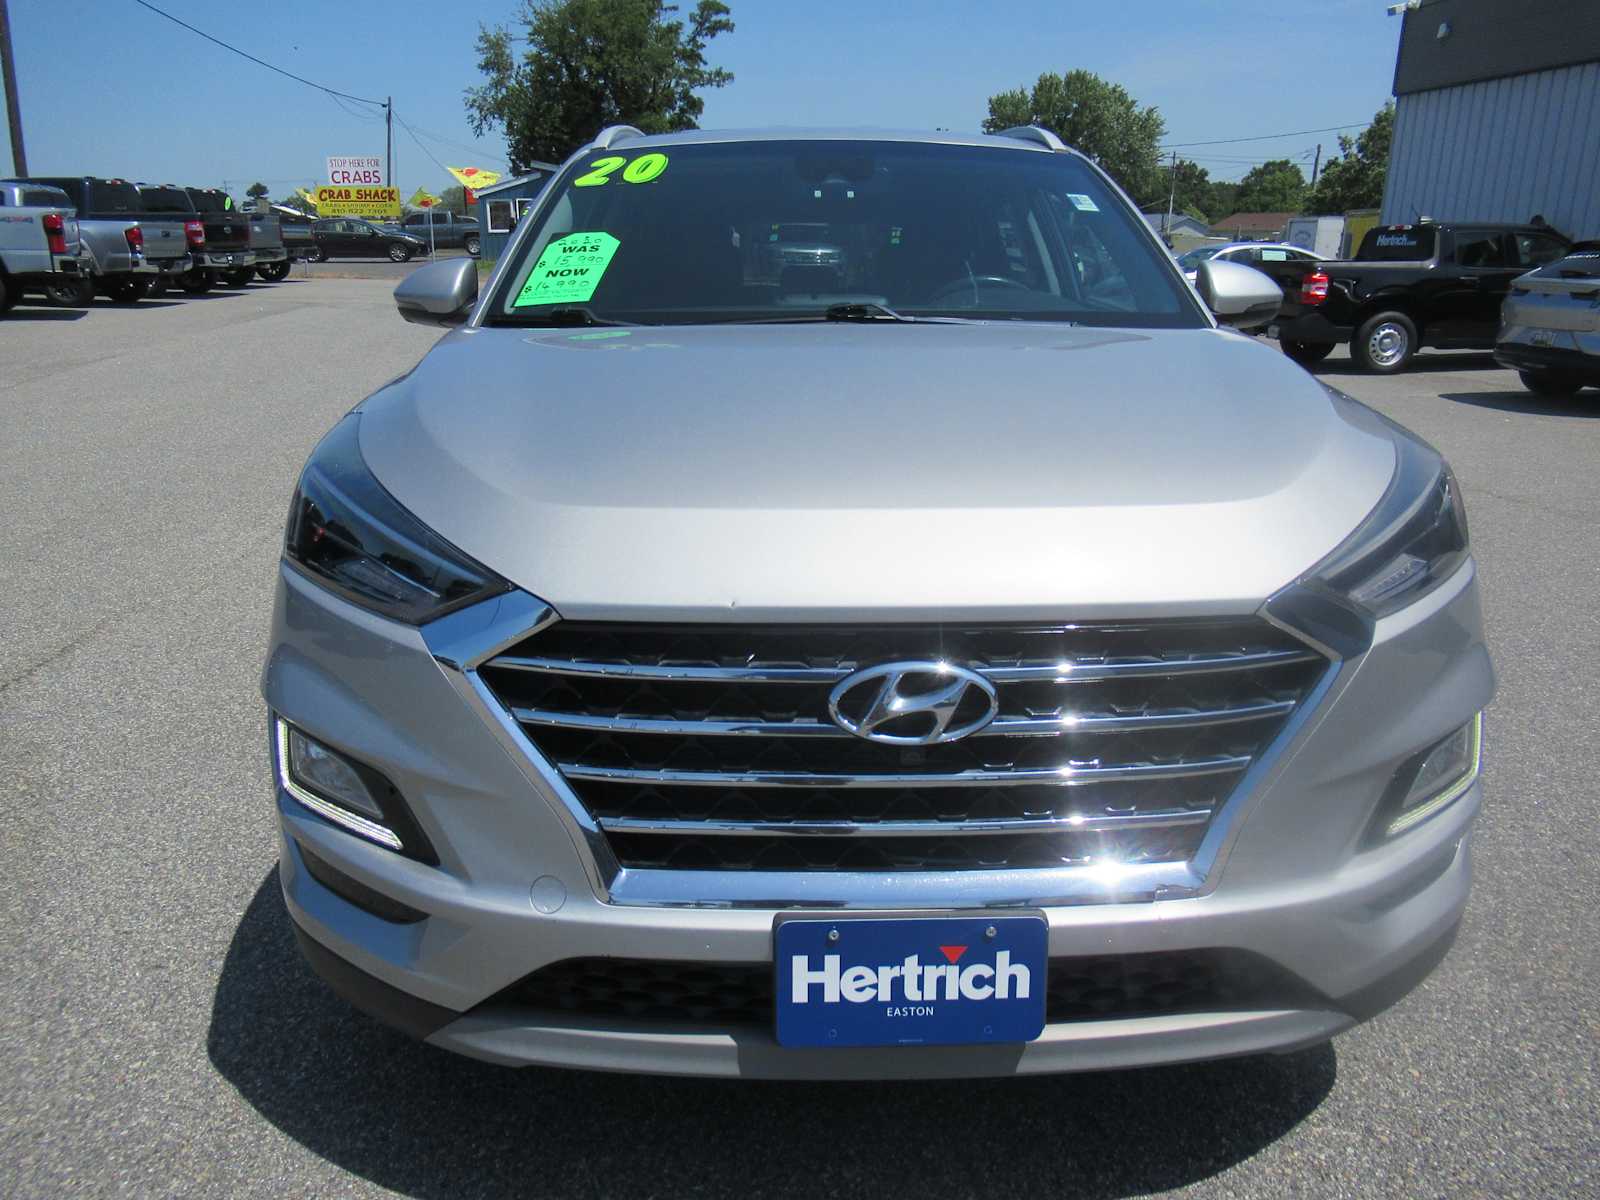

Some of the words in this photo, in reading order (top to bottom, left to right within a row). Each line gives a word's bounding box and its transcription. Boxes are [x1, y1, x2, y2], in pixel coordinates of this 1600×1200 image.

[329, 158, 347, 168] STOP
[349, 158, 365, 168] HERE
[366, 158, 380, 168] FOR
[331, 170, 381, 184] CRABS
[574, 153, 669, 188] 20
[318, 188, 352, 202] CRAB
[356, 188, 397, 202] SHACK
[1376, 234, 1417, 247] Hertrich
[562, 244, 601, 254] WAS
[545, 268, 590, 278] NOW
[792, 946, 1031, 1003] Hertrich
[886, 1006, 934, 1017] EASTON
